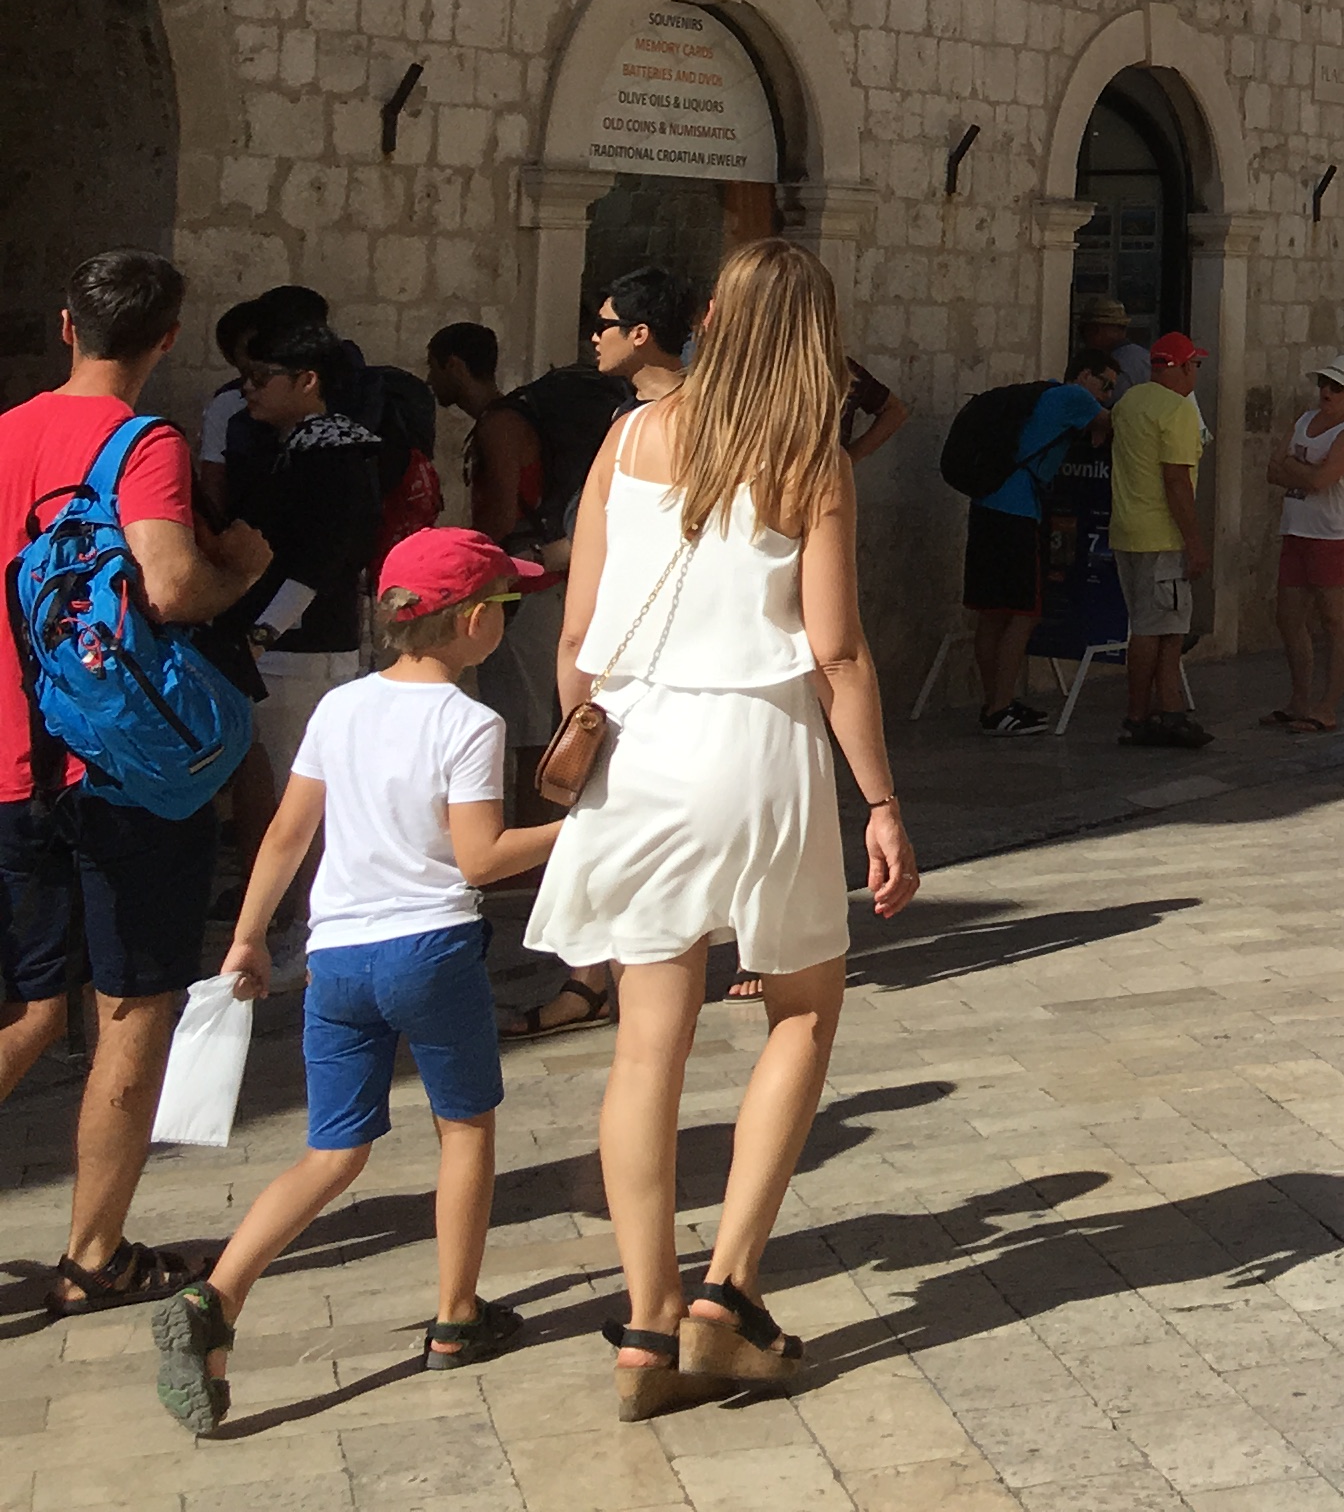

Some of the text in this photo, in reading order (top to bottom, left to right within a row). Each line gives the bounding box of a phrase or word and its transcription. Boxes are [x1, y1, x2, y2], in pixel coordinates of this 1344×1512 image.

[648, 12, 704, 31] SOUVENIRS
[635, 37, 714, 59] MEMORY CARDS
[622, 64, 673, 80] BATTERIES
[676, 70, 695, 83] AND
[618, 90, 725, 113] OLIVE OILS & LIQUORS
[602, 117, 736, 141] OLD COINS & NUMISMATICS
[589, 144, 748, 168] TRADITIONAL CROATIAN JEWELRY
[1061, 460, 1110, 479] ovnik
[1087, 533, 1100, 553] 7
